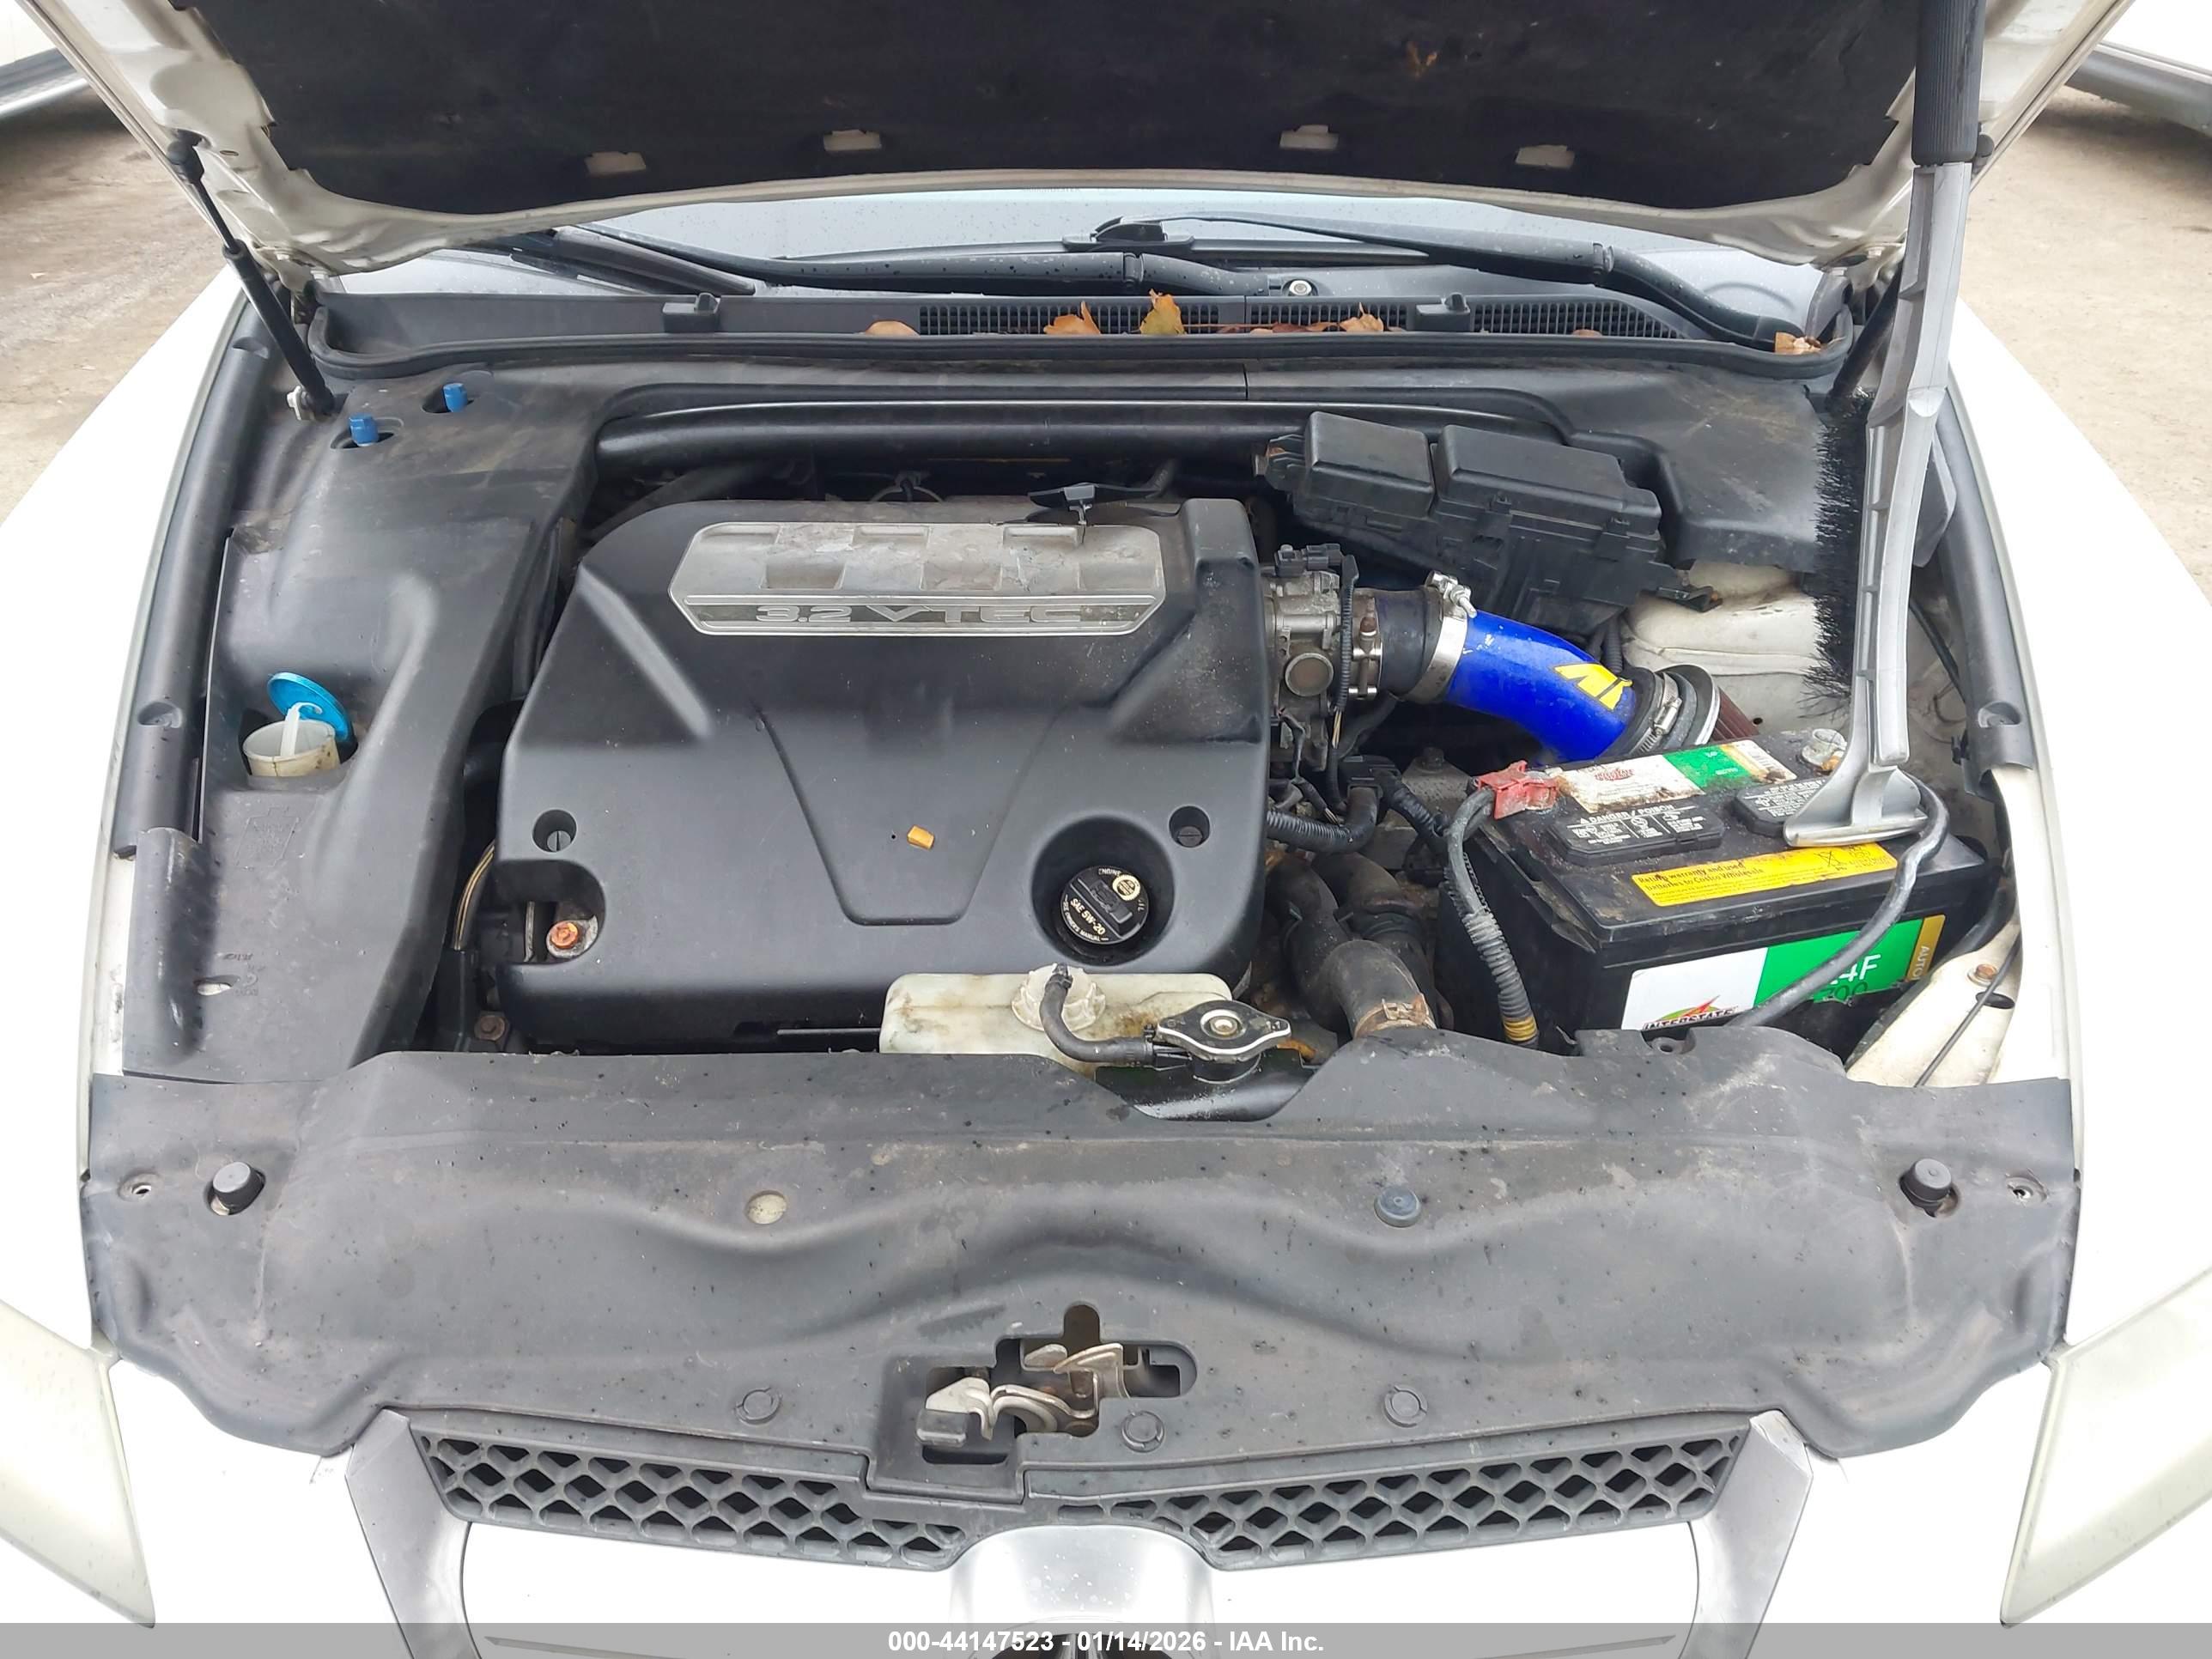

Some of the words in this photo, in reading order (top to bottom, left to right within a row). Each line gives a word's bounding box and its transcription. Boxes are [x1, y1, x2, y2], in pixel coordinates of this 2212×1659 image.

[757, 605, 853, 623] 3.2
[866, 605, 1081, 623] VTEC
[1588, 811, 1631, 823] DANGER
[1637, 805, 1675, 816] POISON
[1646, 878, 1682, 891] batteries
[1683, 878, 1693, 886] to
[1722, 868, 1764, 879] Wholesale
[1669, 868, 1706, 880] warranty
[1708, 866, 1724, 874] and
[1724, 861, 1744, 872] used
[1070, 898, 1085, 914] SAE
[1081, 910, 1106, 935] 5W-20
[1079, 930, 1101, 942] MANUAL
[1830, 954, 1881, 984] 4F
